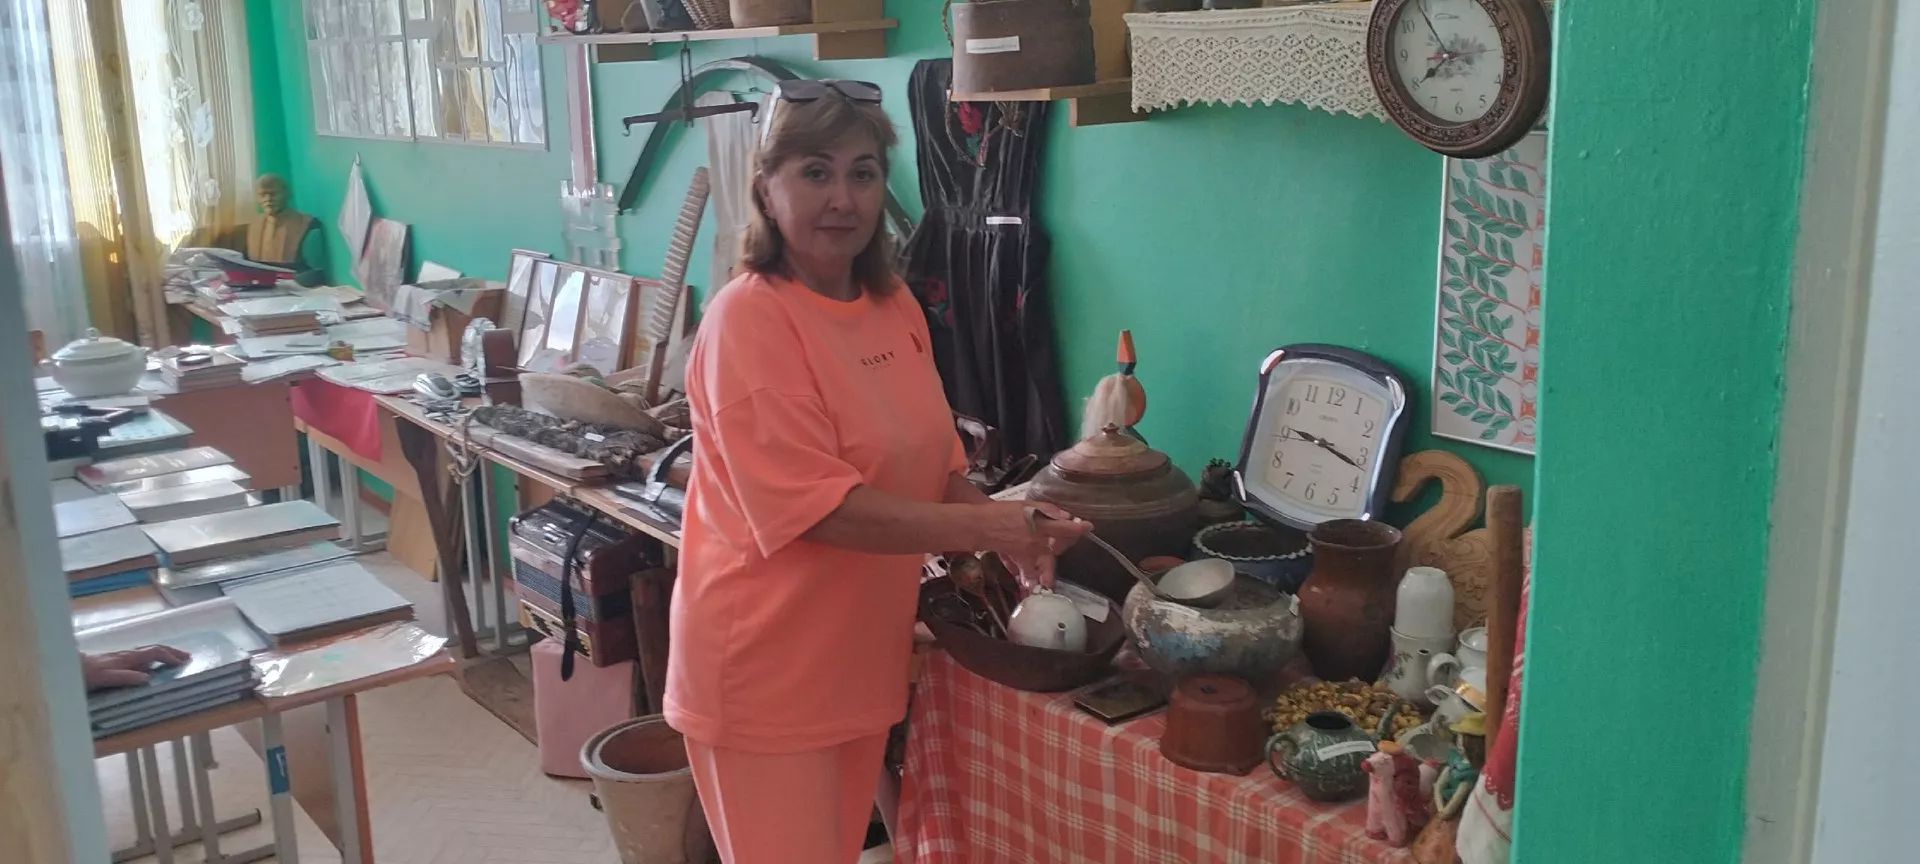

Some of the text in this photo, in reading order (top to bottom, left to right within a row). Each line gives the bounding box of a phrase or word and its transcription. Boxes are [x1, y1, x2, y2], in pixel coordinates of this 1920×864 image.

[1400, 18, 1415, 34] 10
[1400, 49, 1408, 64] 9
[1411, 77, 1420, 91] 8
[1429, 96, 1438, 110] 7
[1455, 101, 1463, 116] 6
[1479, 94, 1486, 108] 5
[1305, 384, 1319, 403] 11
[1326, 386, 1346, 407] 12
[1286, 397, 1300, 416] 10
[1354, 397, 1363, 415] 1
[1280, 425, 1291, 442] 9
[1362, 420, 1374, 439] 2
[1272, 450, 1283, 468] 8
[1356, 447, 1369, 466] 3
[1283, 471, 1295, 490] 7
[1350, 475, 1360, 493] 4
[1304, 482, 1317, 500] 6
[1327, 487, 1340, 505] 5
